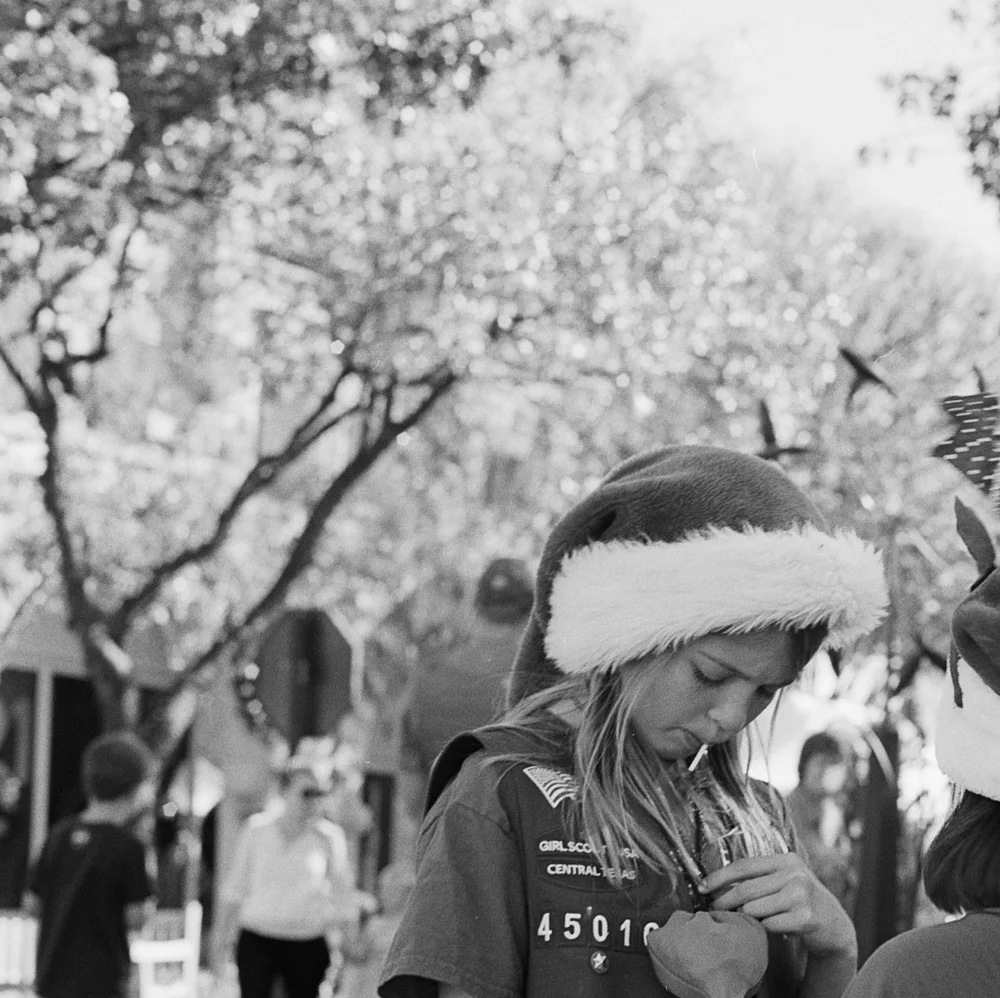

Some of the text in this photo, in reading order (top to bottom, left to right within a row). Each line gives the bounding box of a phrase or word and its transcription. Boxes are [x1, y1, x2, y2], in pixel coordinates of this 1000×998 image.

[539, 840, 567, 852] GIRL
[547, 864, 637, 880] CENTRAL TEAS
